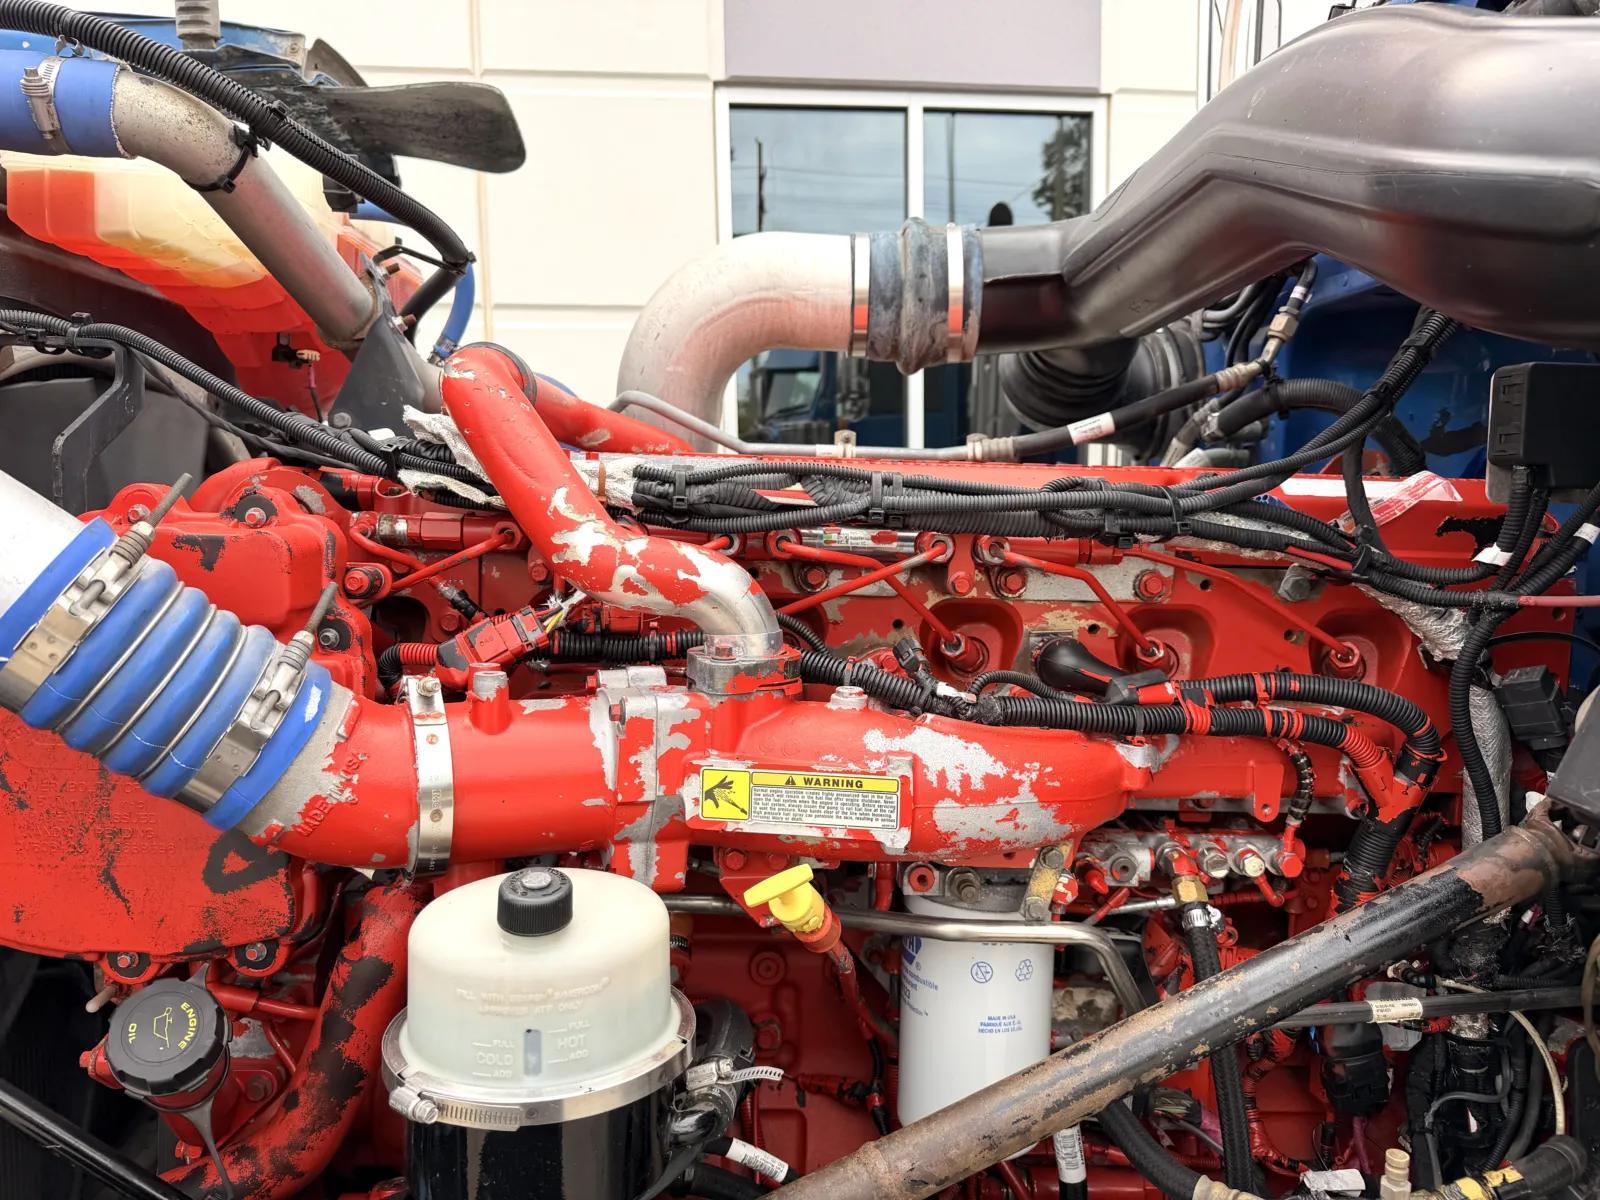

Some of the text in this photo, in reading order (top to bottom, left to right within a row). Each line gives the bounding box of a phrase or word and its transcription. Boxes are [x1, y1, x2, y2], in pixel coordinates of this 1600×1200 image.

[803, 777, 864, 789] WARNING
[293, 799, 335, 837] MADE
[178, 1002, 197, 1050] ENGINE
[568, 1019, 592, 1031] FULL
[128, 1023, 137, 1044] OIL
[492, 1039, 516, 1049] FULL
[556, 1033, 587, 1050] HOT
[475, 1051, 514, 1066] COLD
[568, 1049, 590, 1060] ADD
[493, 1070, 513, 1079] ADD
